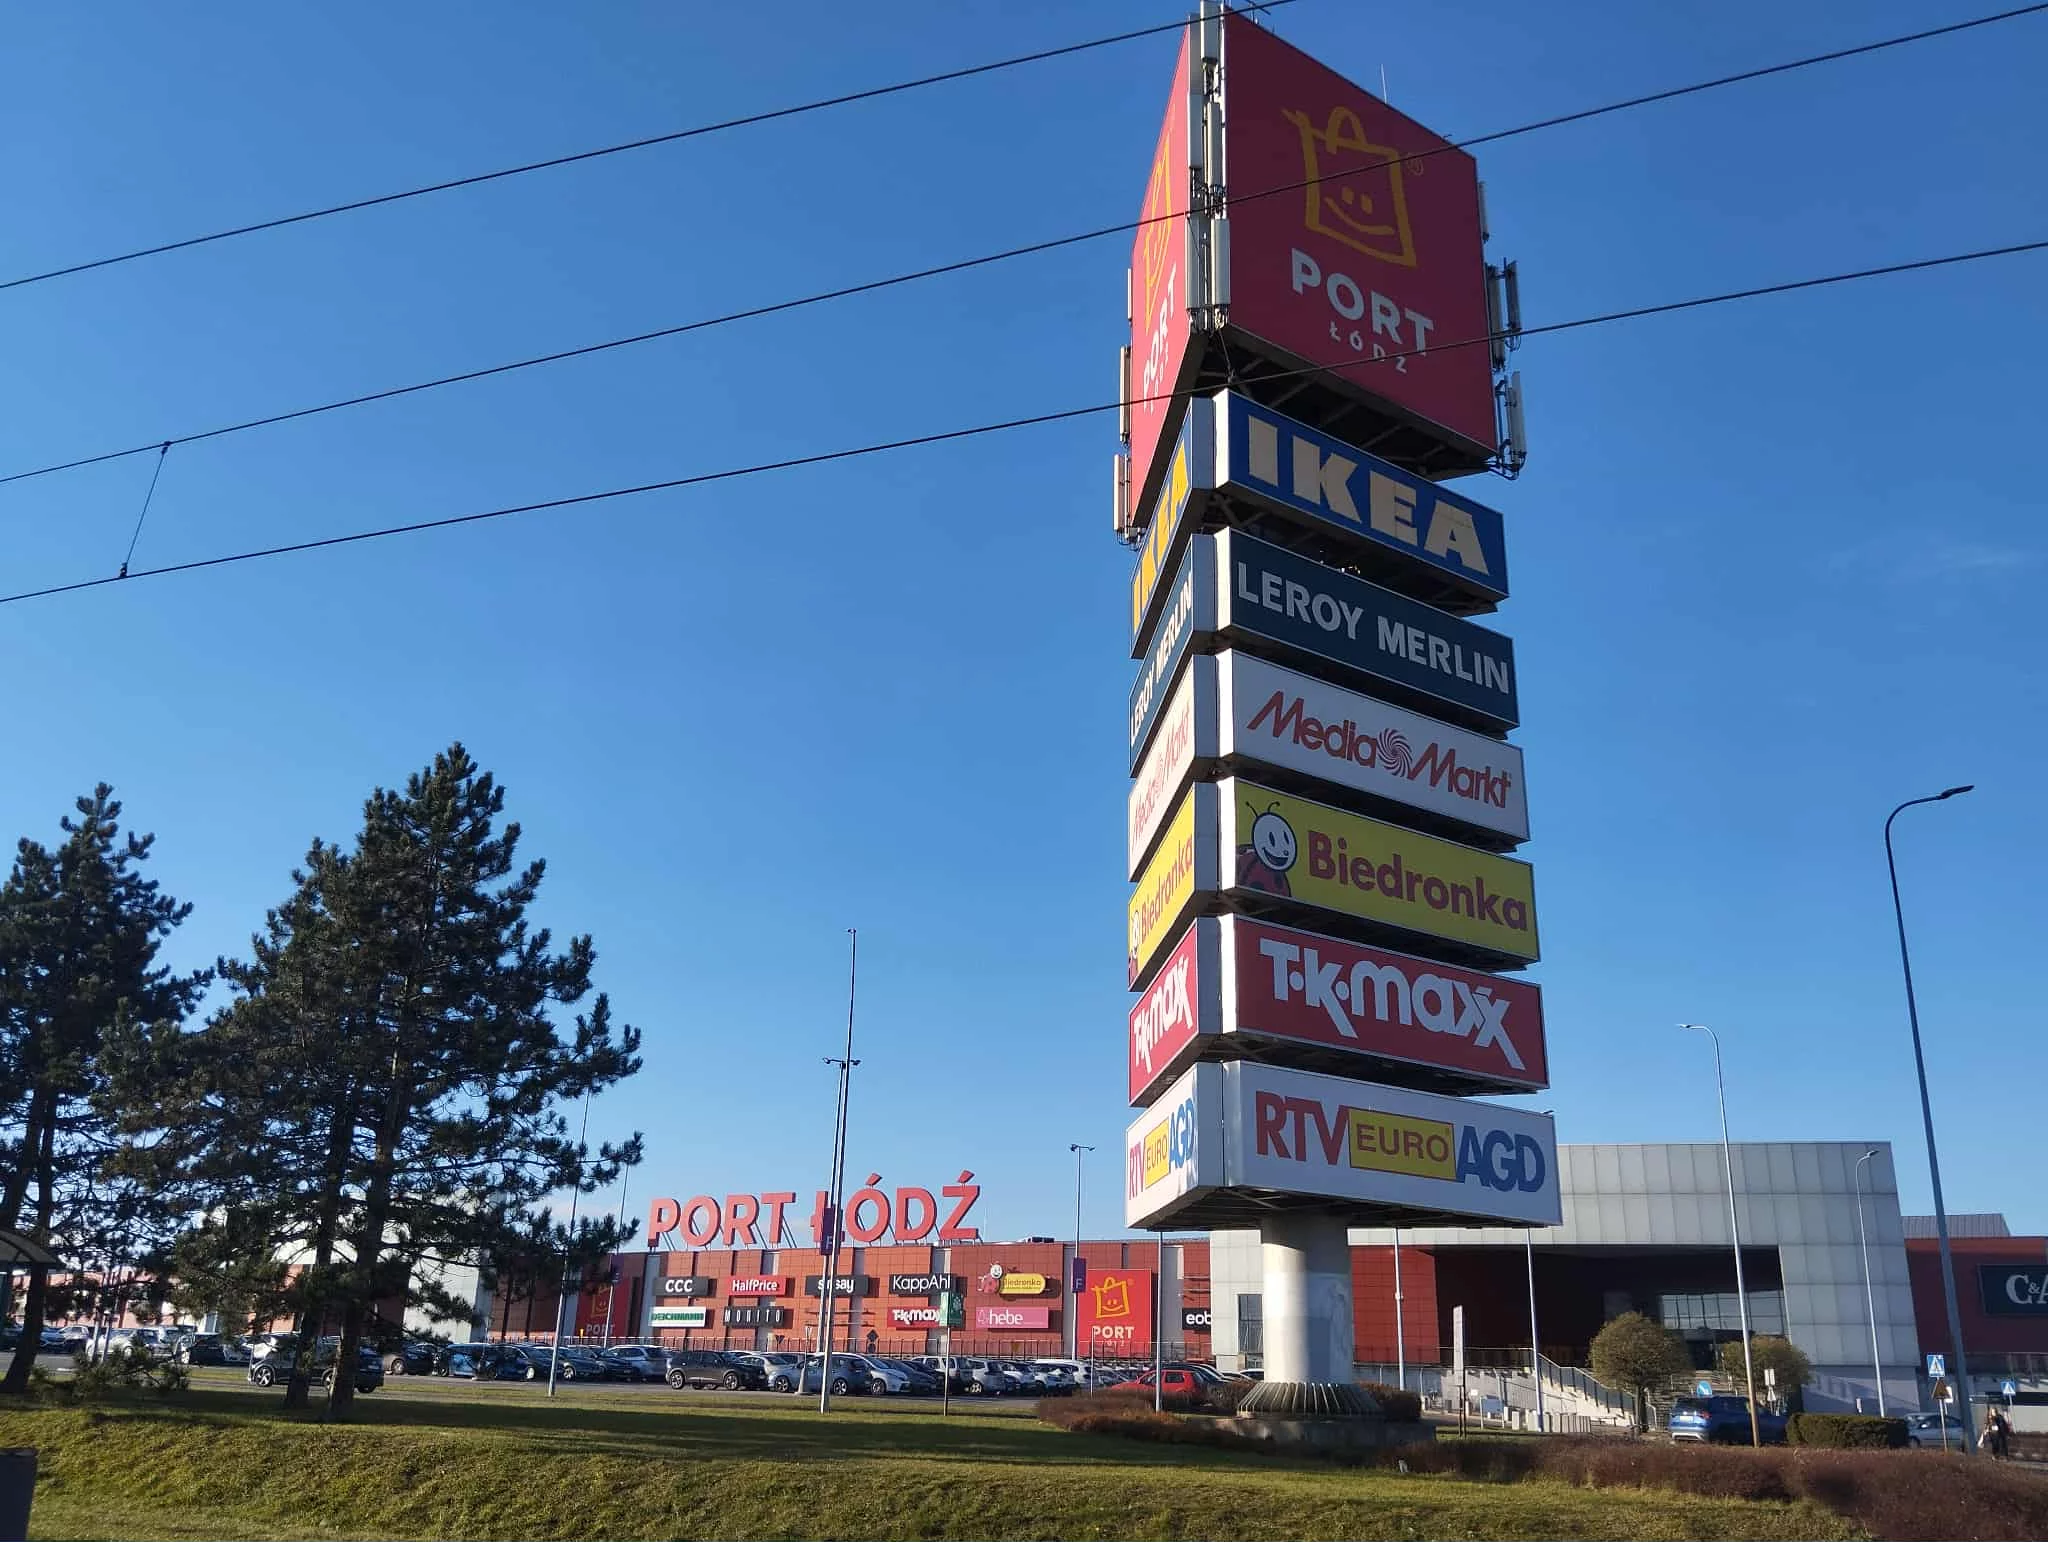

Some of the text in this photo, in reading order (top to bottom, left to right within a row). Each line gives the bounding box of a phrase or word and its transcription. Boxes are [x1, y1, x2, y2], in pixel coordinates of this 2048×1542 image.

[1143, 261, 1177, 414] PORT
[1291, 247, 1434, 358] PORT
[1133, 438, 1189, 635] IKEA
[1248, 415, 1490, 576] IKEA
[1131, 572, 1193, 747] LEROY MERLIN
[1237, 561, 1509, 695] LEROY MERLIN
[1247, 690, 1512, 809] Media Markt
[1141, 833, 1193, 945] Biedronka
[1307, 829, 1528, 932] Biedronka
[1129, 1097, 1194, 1200] RTV EURO AGD
[1255, 1090, 1546, 1193] RTV EURO AGD
[647, 1169, 981, 1247] PORT ŁÓDŹ
[665, 1279, 693, 1292] CCC
[732, 1279, 778, 1292] HalfPrice
[893, 1273, 951, 1292] KappAhl
[989, 1308, 1023, 1325] hebe
[1092, 1325, 1135, 1339] PORT
